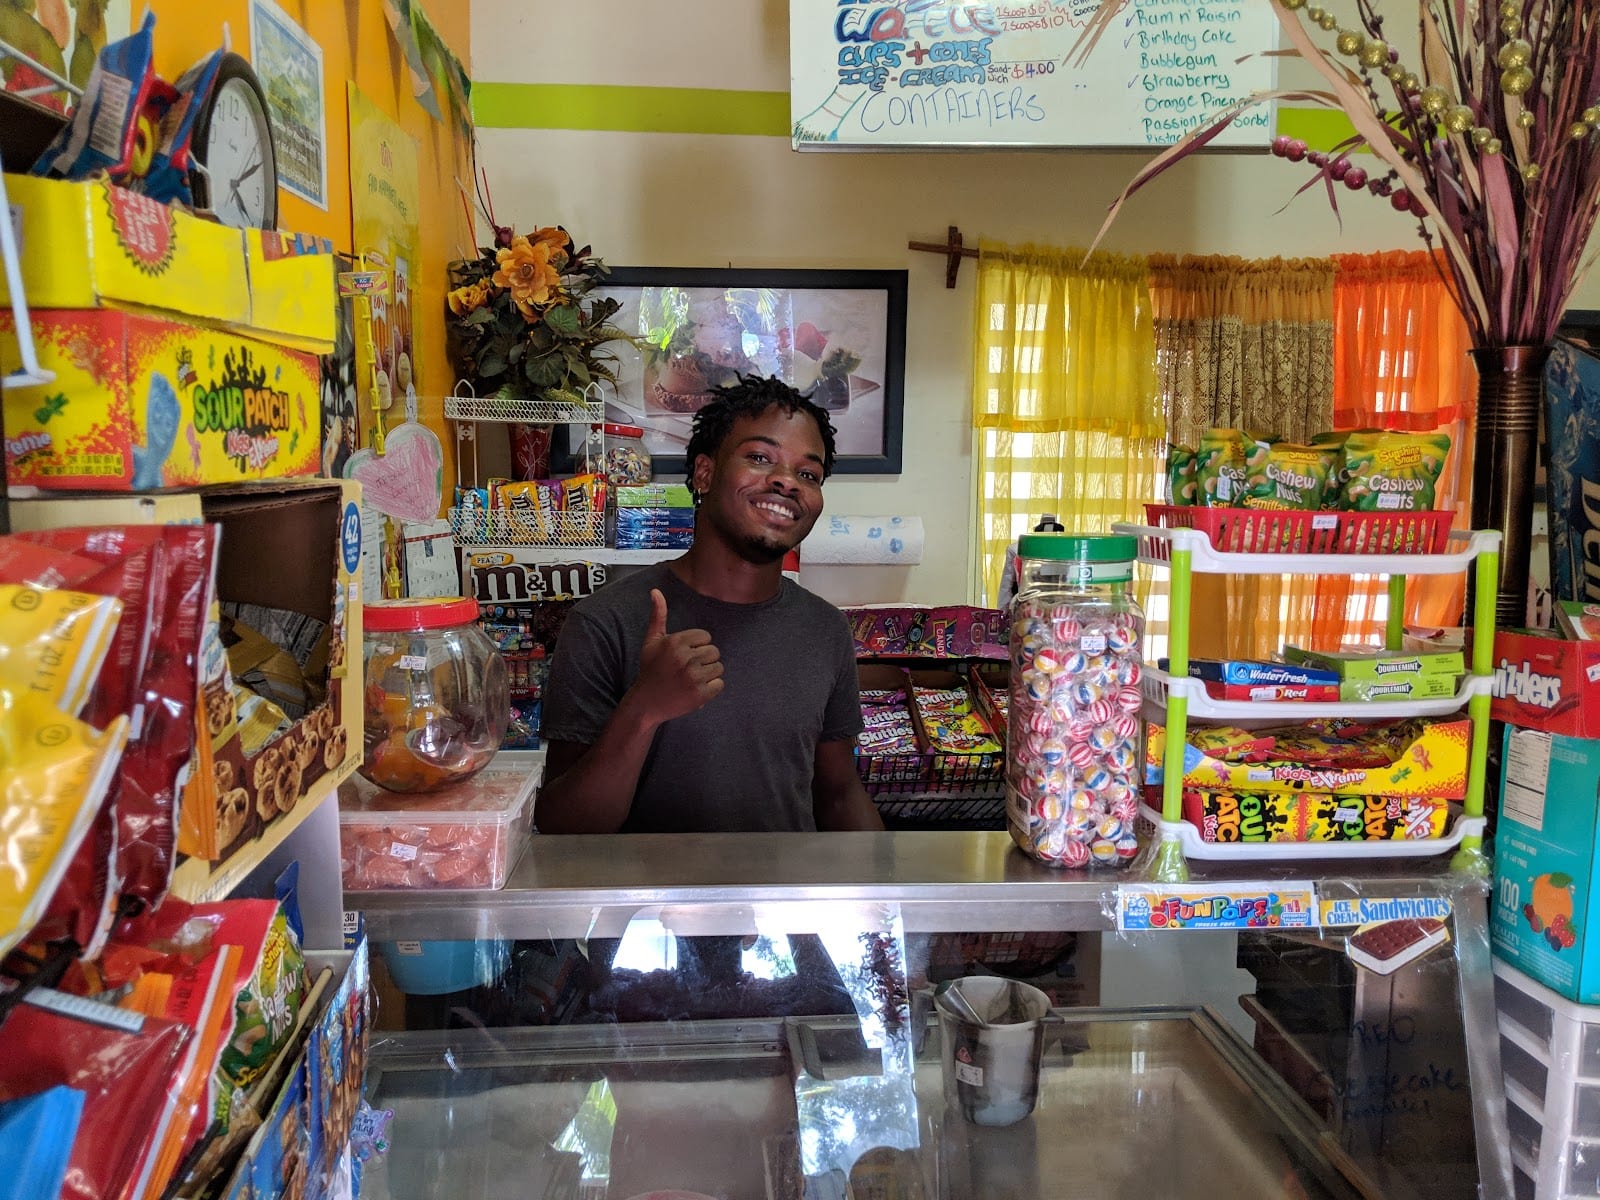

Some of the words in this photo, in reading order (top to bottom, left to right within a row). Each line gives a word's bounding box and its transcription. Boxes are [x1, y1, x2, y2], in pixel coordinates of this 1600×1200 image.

[1139, 29, 1196, 50] Birthday
[1202, 29, 1236, 44] Cake
[1140, 52, 1217, 70] Bubblegum
[1142, 74, 1230, 91] Strawberry
[1145, 95, 1198, 113] Orange
[1142, 115, 1196, 133] Passion
[193, 385, 245, 433] SOUR
[243, 387, 289, 432] PATCH
[1266, 463, 1317, 490] Cashew
[1368, 474, 1424, 493] Cashew
[1276, 482, 1303, 504] Nuts
[345, 514, 358, 545] 42
[473, 562, 605, 601] m&m's
[935, 628, 946, 657] CANDY
[1249, 669, 1308, 684] Winterfresh
[1378, 663, 1418, 674] DOUBLEMINT
[917, 690, 968, 706] Skittles
[1284, 689, 1308, 698] Red
[1370, 686, 1410, 695] DOUBLEMINT
[857, 727, 914, 746] Skittles
[1273, 767, 1312, 781] Kids
[1215, 790, 1241, 842] ATC
[1387, 797, 1402, 819] Kid
[1500, 875, 1519, 912] 100
[344, 912, 355, 922] 30
[1326, 910, 1360, 925] CREAM
[1334, 901, 1352, 912] ICE
[1359, 897, 1451, 924] Sandwiches
